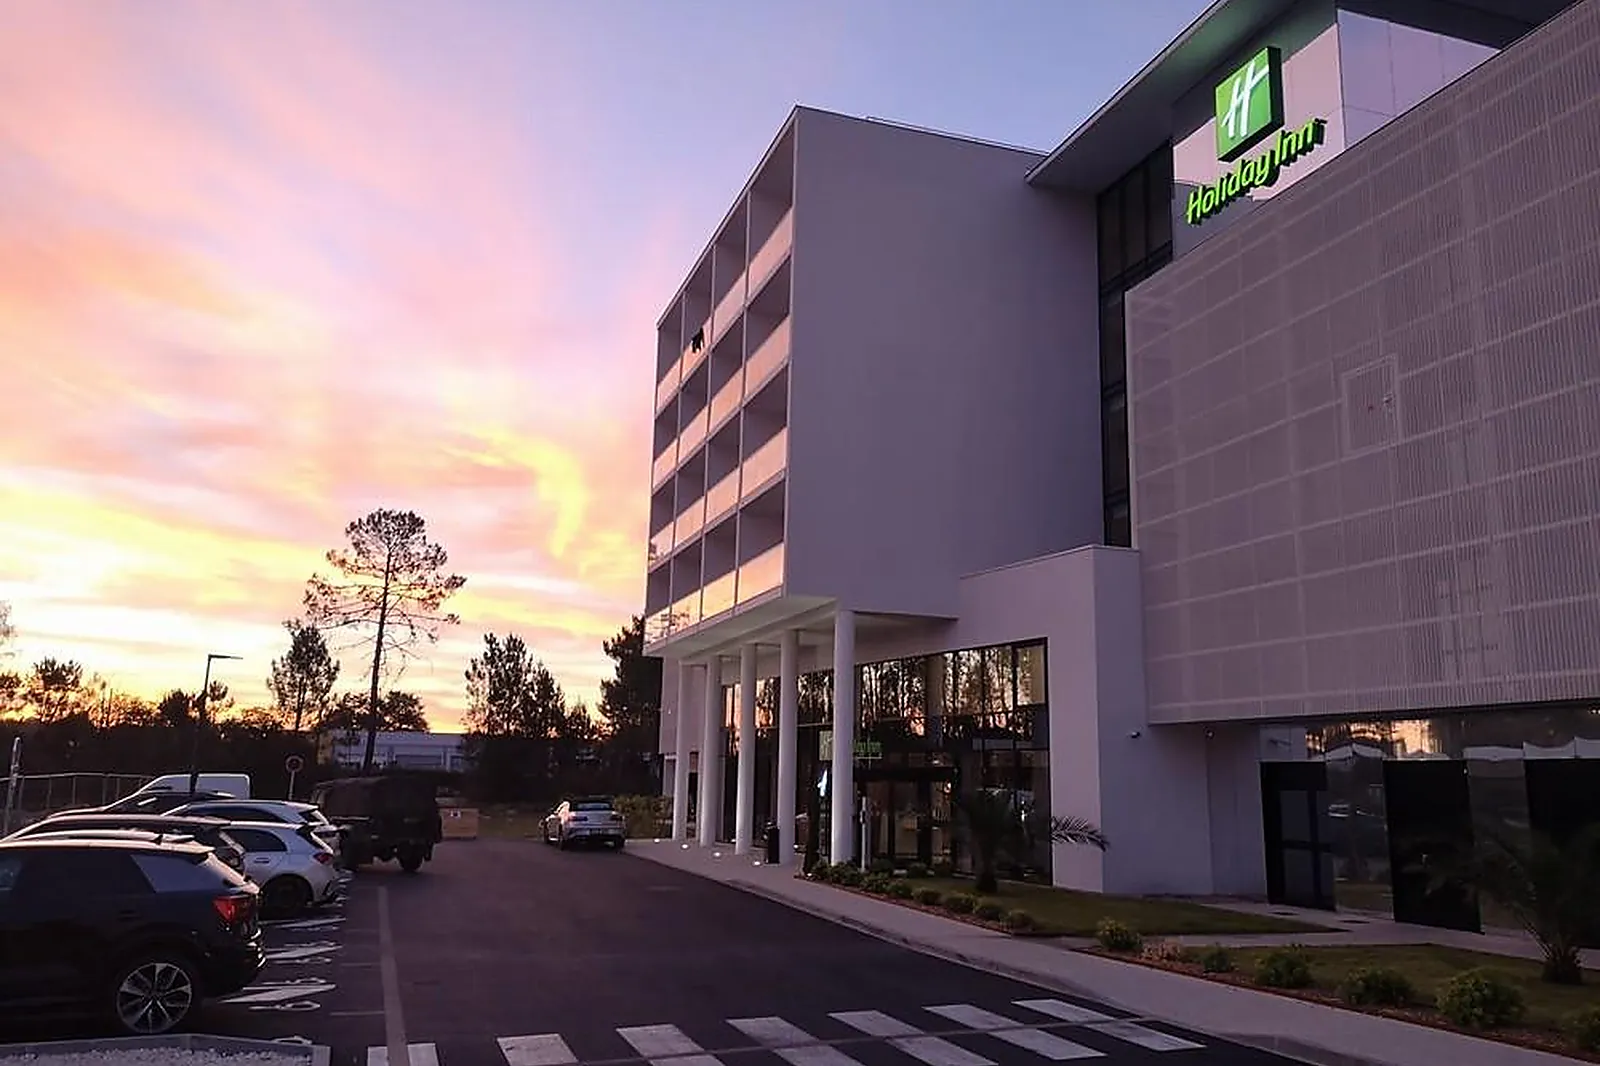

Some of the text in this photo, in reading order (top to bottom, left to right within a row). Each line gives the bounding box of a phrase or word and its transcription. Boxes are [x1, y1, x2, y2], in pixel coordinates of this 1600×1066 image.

[1221, 58, 1270, 138] H
[1186, 119, 1319, 225] Holiday Inn
